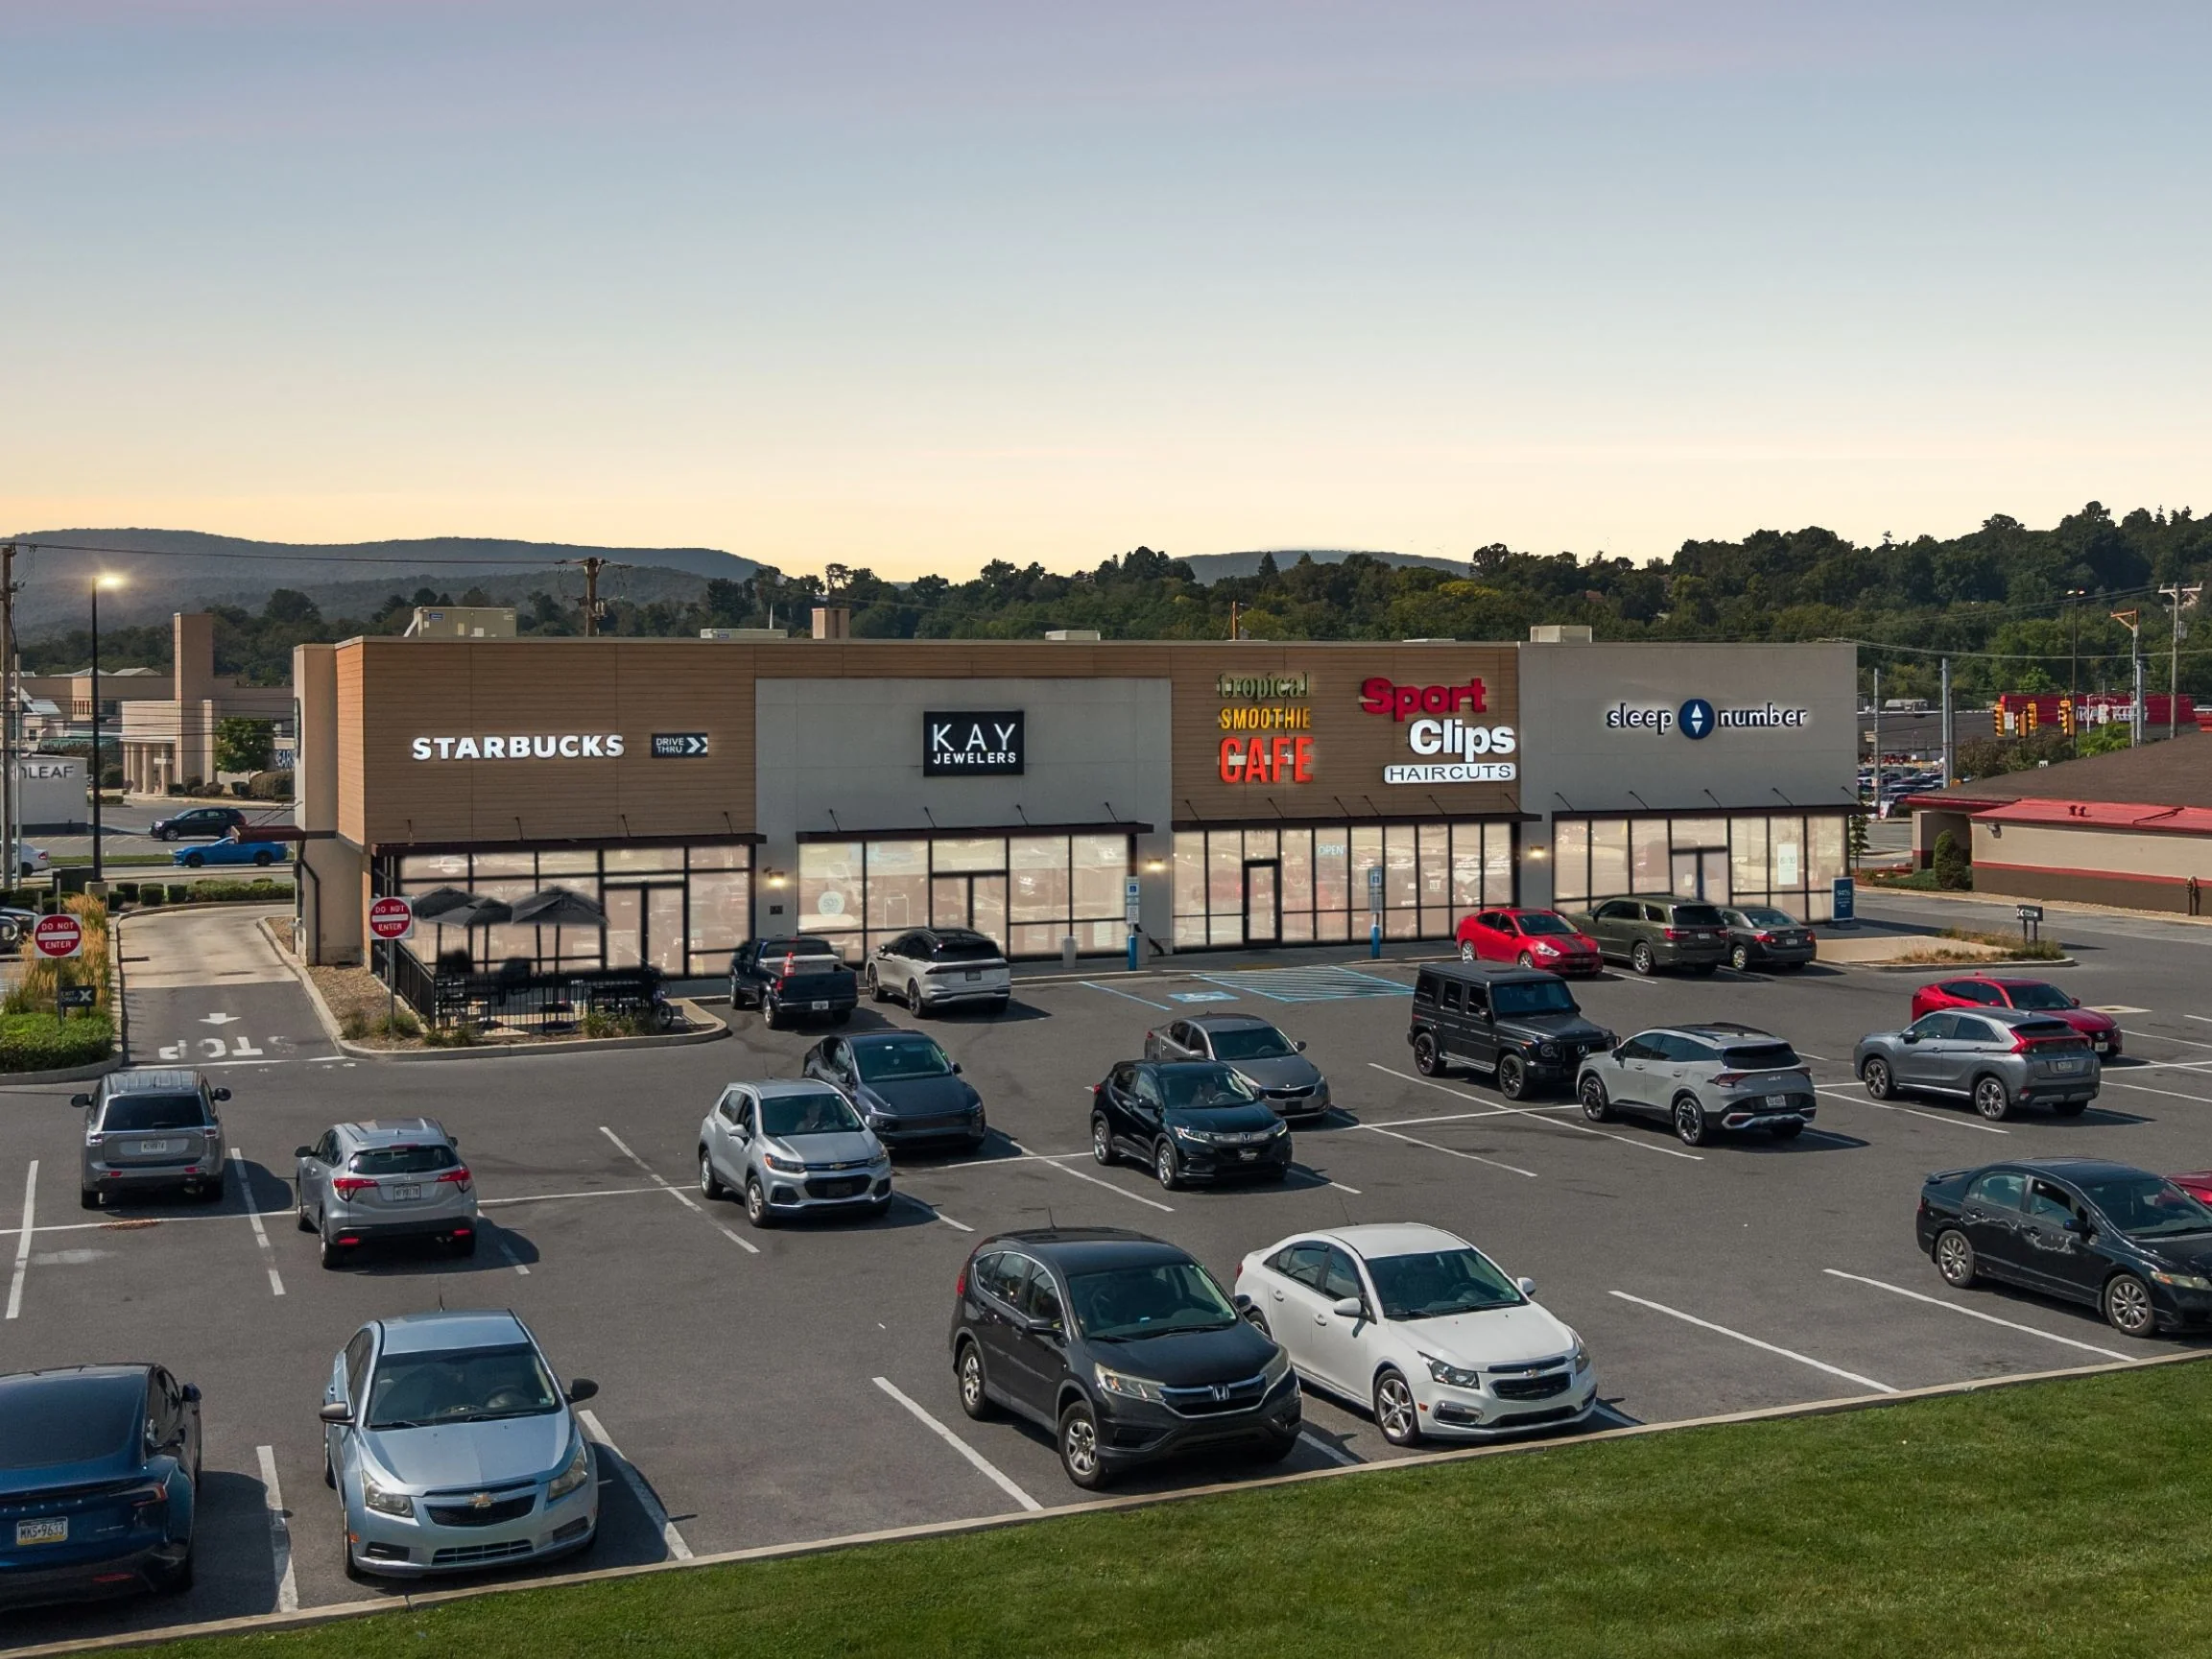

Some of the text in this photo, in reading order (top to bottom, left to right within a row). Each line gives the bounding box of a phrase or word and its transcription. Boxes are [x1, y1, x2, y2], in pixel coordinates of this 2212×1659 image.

[1218, 672, 1311, 703] tropical
[1361, 676, 1487, 723] Sport
[1219, 707, 1312, 730] SMOOTHIE
[1606, 701, 1808, 735] sleep number
[413, 735, 625, 760] STARBUCKS
[655, 737, 685, 746] DRIVE
[933, 723, 1016, 751] KAY
[1408, 719, 1516, 763] Clips
[933, 752, 1017, 765] JEWELERS
[1219, 735, 1315, 784] CAFE
[1390, 765, 1511, 782] HAIRCUTS
[390, 905, 405, 913] NOT
[378, 922, 403, 932] ENTER
[44, 940, 72, 949] ENTER
